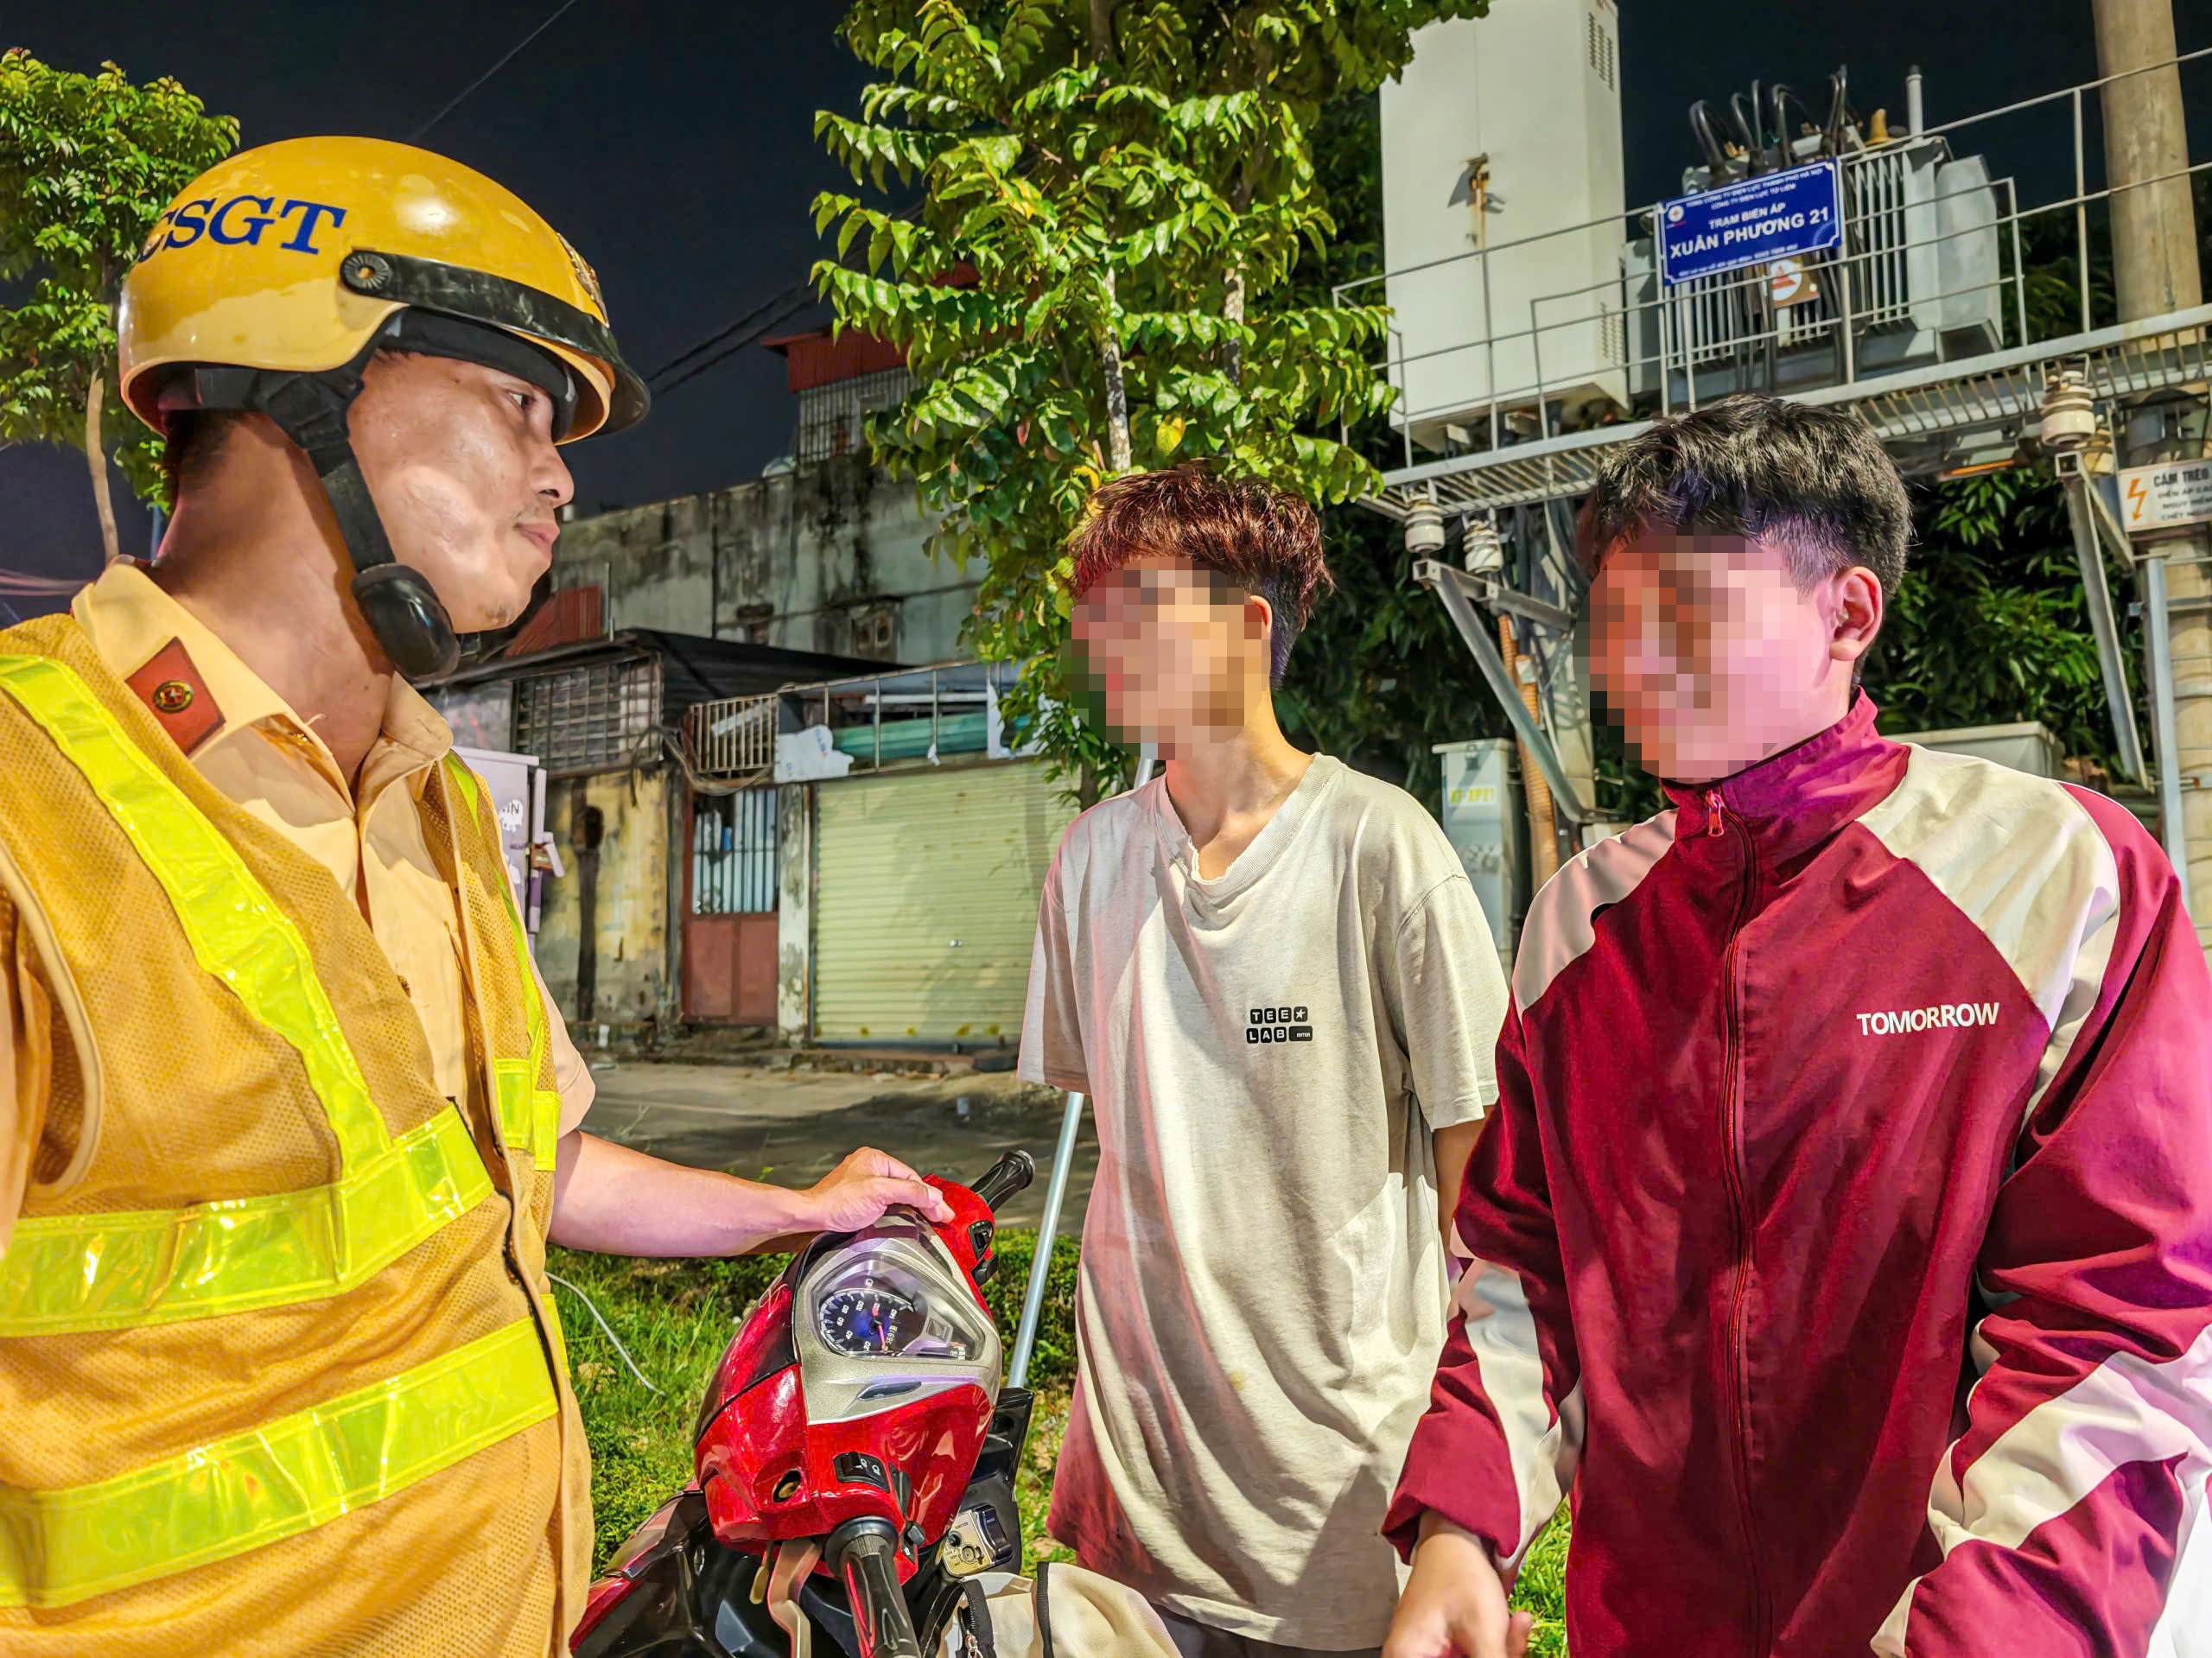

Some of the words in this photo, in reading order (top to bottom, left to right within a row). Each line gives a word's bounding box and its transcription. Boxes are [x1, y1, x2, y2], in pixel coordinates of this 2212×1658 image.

[1770, 201, 1786, 215] ÁP
[137, 195, 347, 263] CSGT
[1669, 232, 1719, 259] XUÂN
[1723, 213, 1805, 245] PHƯƠNG
[1809, 206, 1828, 225] 21
[1252, 1009, 1289, 1022] TEE
[1857, 1002, 1999, 1035] TOMORROW
[1249, 1029, 1285, 1041] LAB
[841, 1305, 849, 1314] 80
[855, 1300, 864, 1312] 100
[889, 1308, 898, 1319] 140
[836, 1317, 844, 1326] 60
[845, 1330, 853, 1340] 40
[863, 1341, 871, 1351] 20
